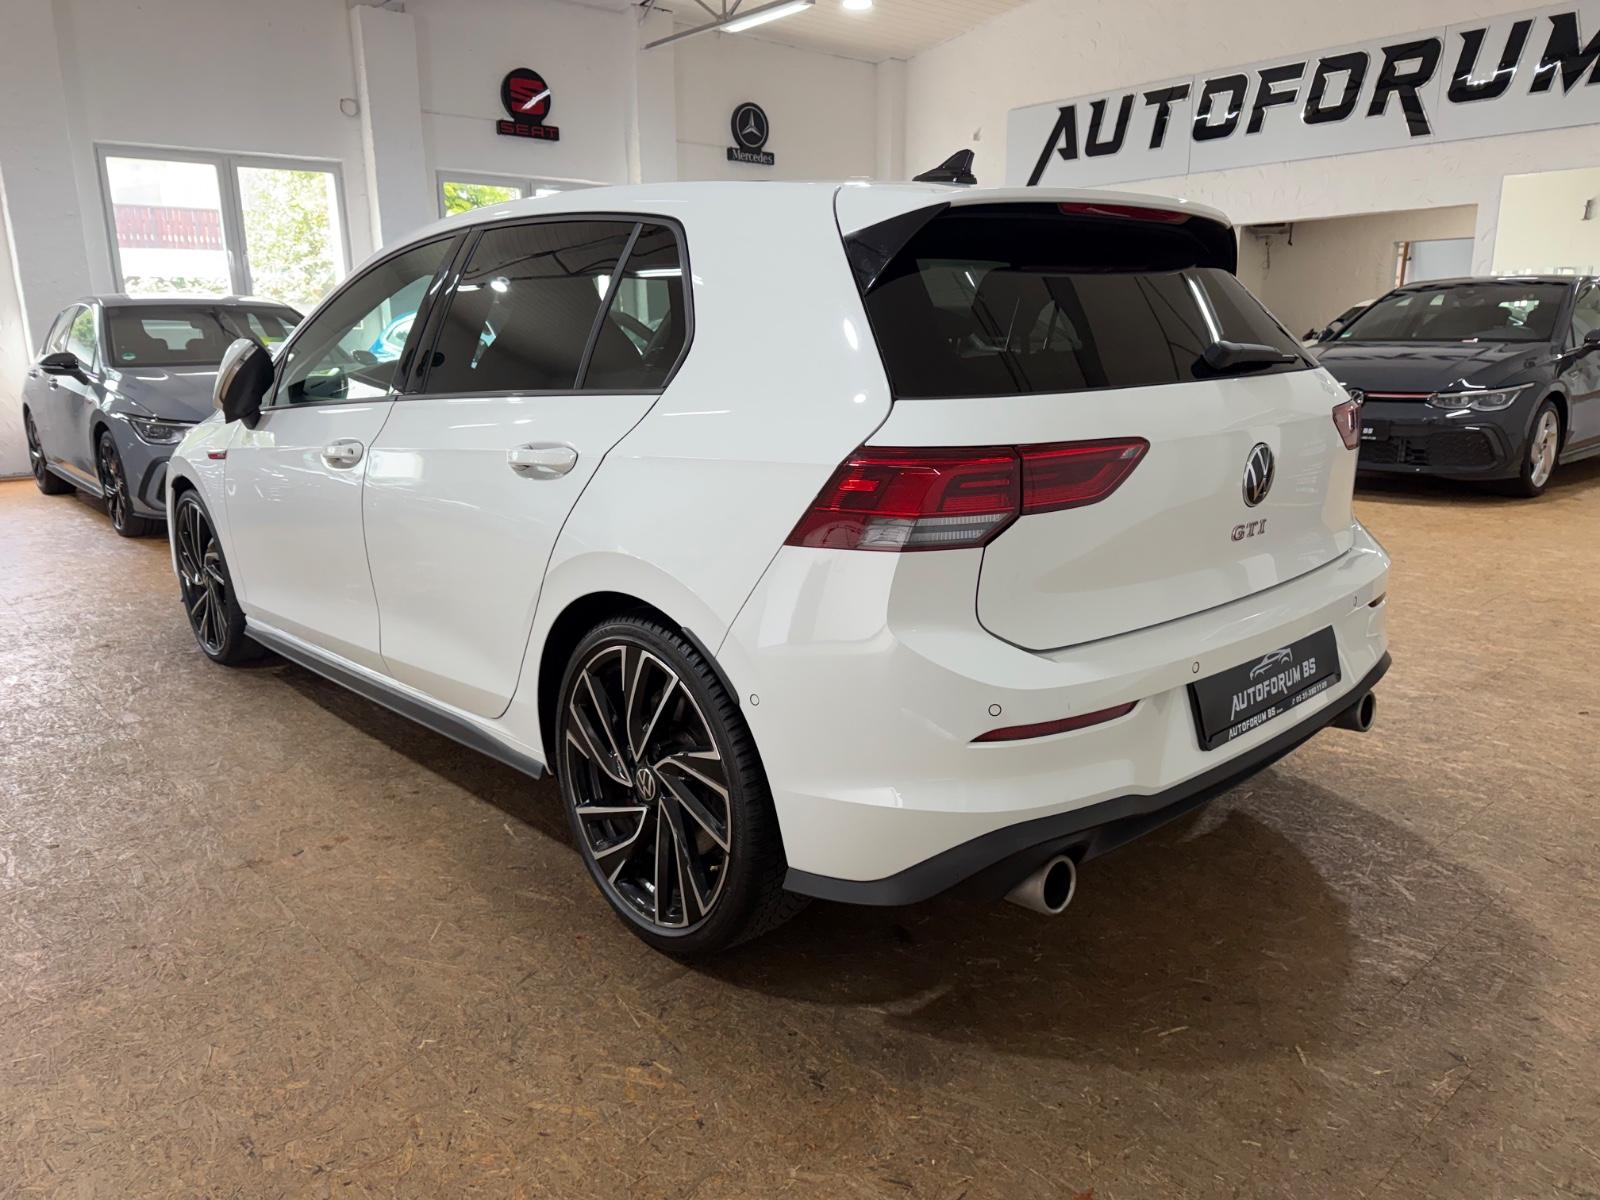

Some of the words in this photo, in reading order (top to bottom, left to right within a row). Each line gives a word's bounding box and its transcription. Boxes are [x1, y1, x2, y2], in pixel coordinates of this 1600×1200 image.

[1026, 9, 1600, 188] AUTOFORUM
[500, 121, 558, 138] SEAT
[731, 148, 773, 165] Mercedes
[1230, 518, 1267, 542] GTI
[1230, 664, 1301, 721] AUTOFORUM
[1302, 657, 1317, 678] BS
[1228, 710, 1268, 740] AUTOFORUM
